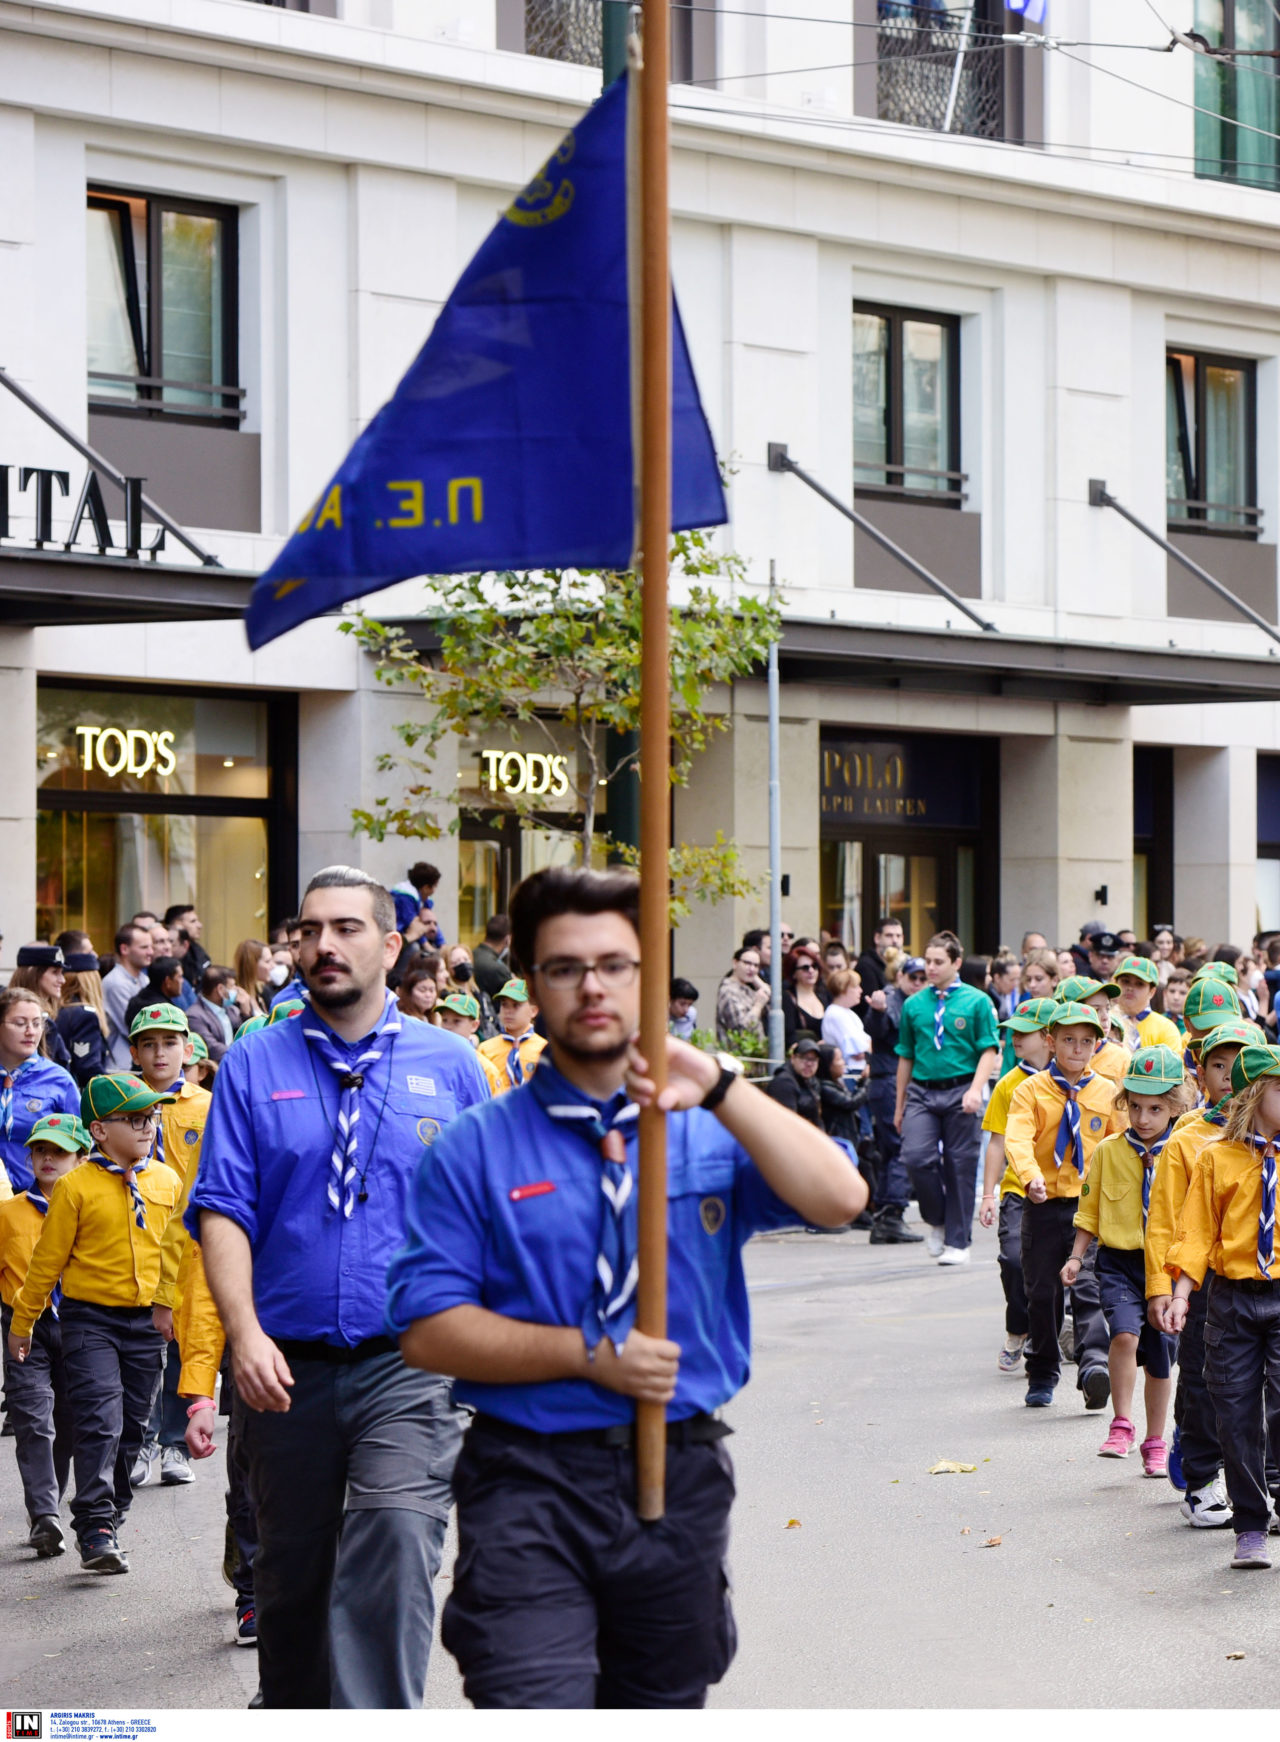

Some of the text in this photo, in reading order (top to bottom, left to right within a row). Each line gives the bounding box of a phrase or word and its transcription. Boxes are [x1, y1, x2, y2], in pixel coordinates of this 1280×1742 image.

[75, 726, 176, 777] TOD'S
[481, 749, 569, 797] TOD'S
[823, 750, 904, 788] POLO
[821, 794, 926, 815] LPH LAUREN
